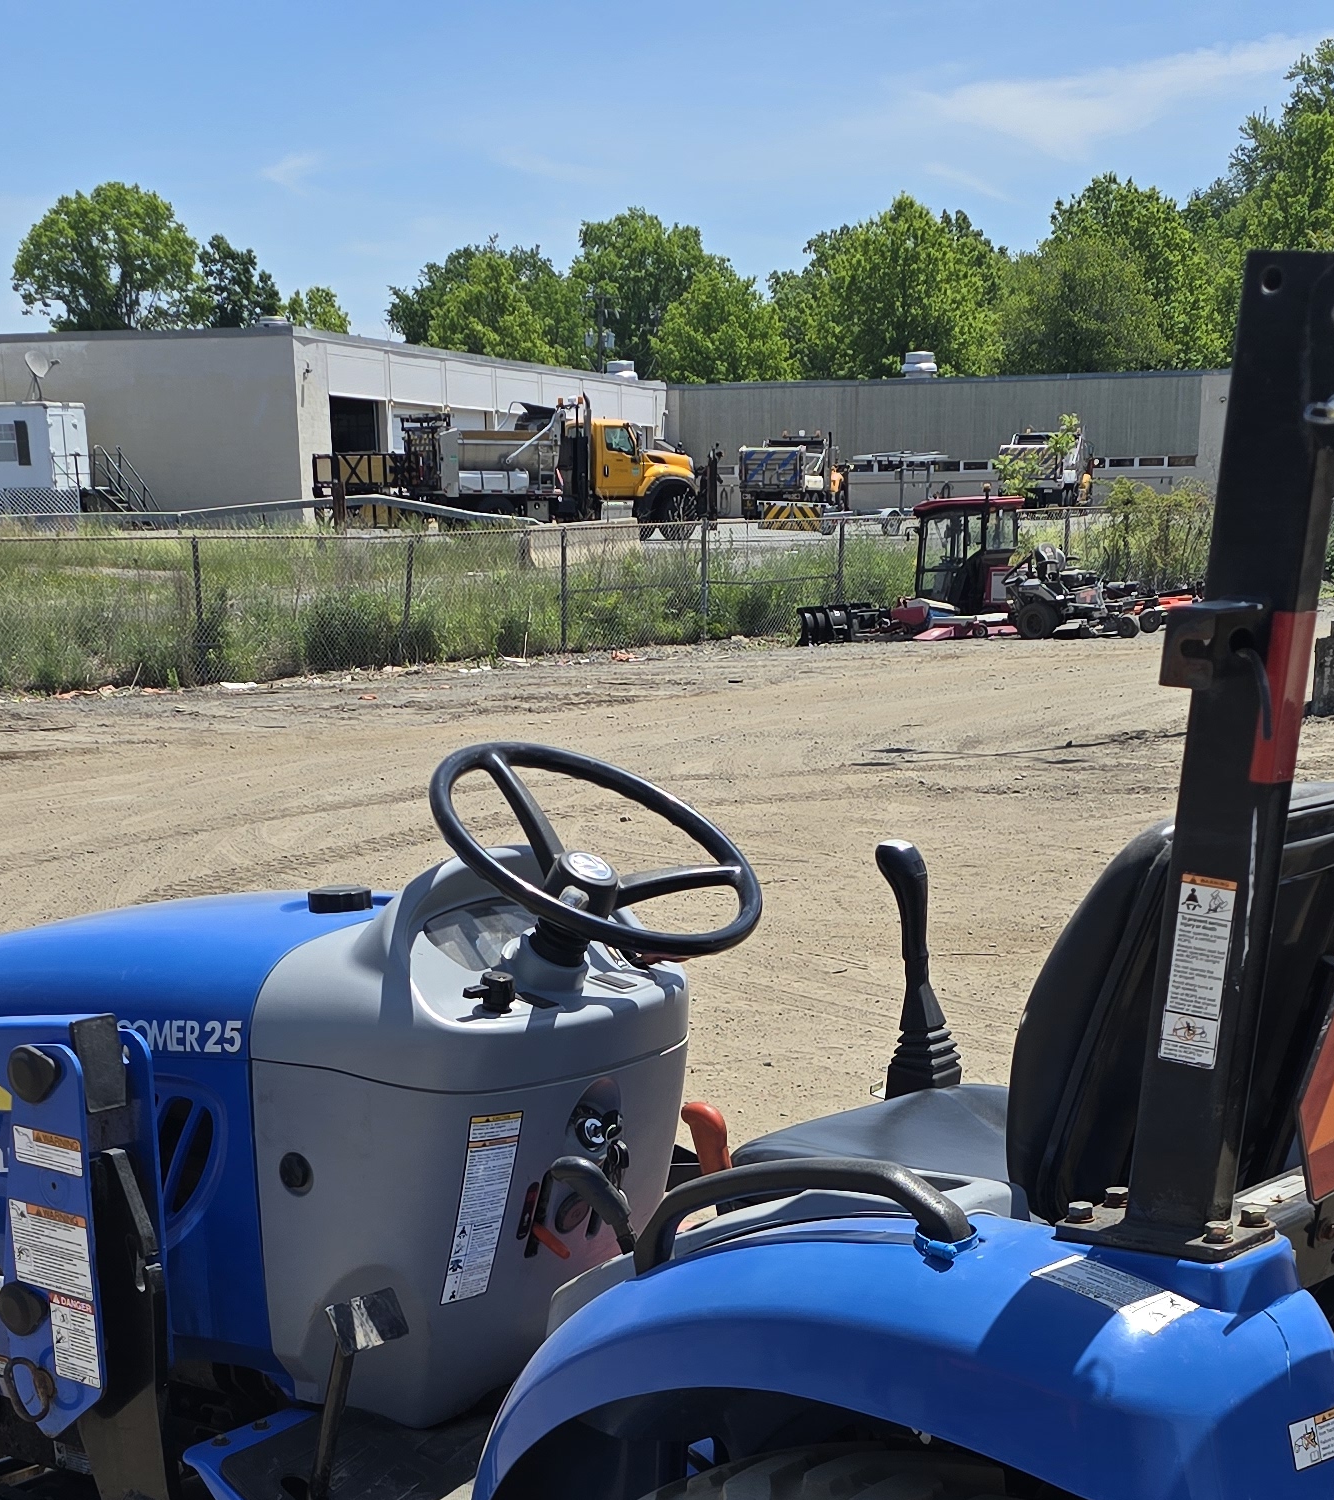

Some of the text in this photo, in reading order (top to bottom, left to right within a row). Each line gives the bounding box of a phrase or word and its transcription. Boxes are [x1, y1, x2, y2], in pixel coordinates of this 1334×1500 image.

[204, 1020, 242, 1053] 25
[42, 1133, 79, 1151] WARNING
[43, 1208, 78, 1226] WARNING
[60, 1296, 92, 1313] DANGER
